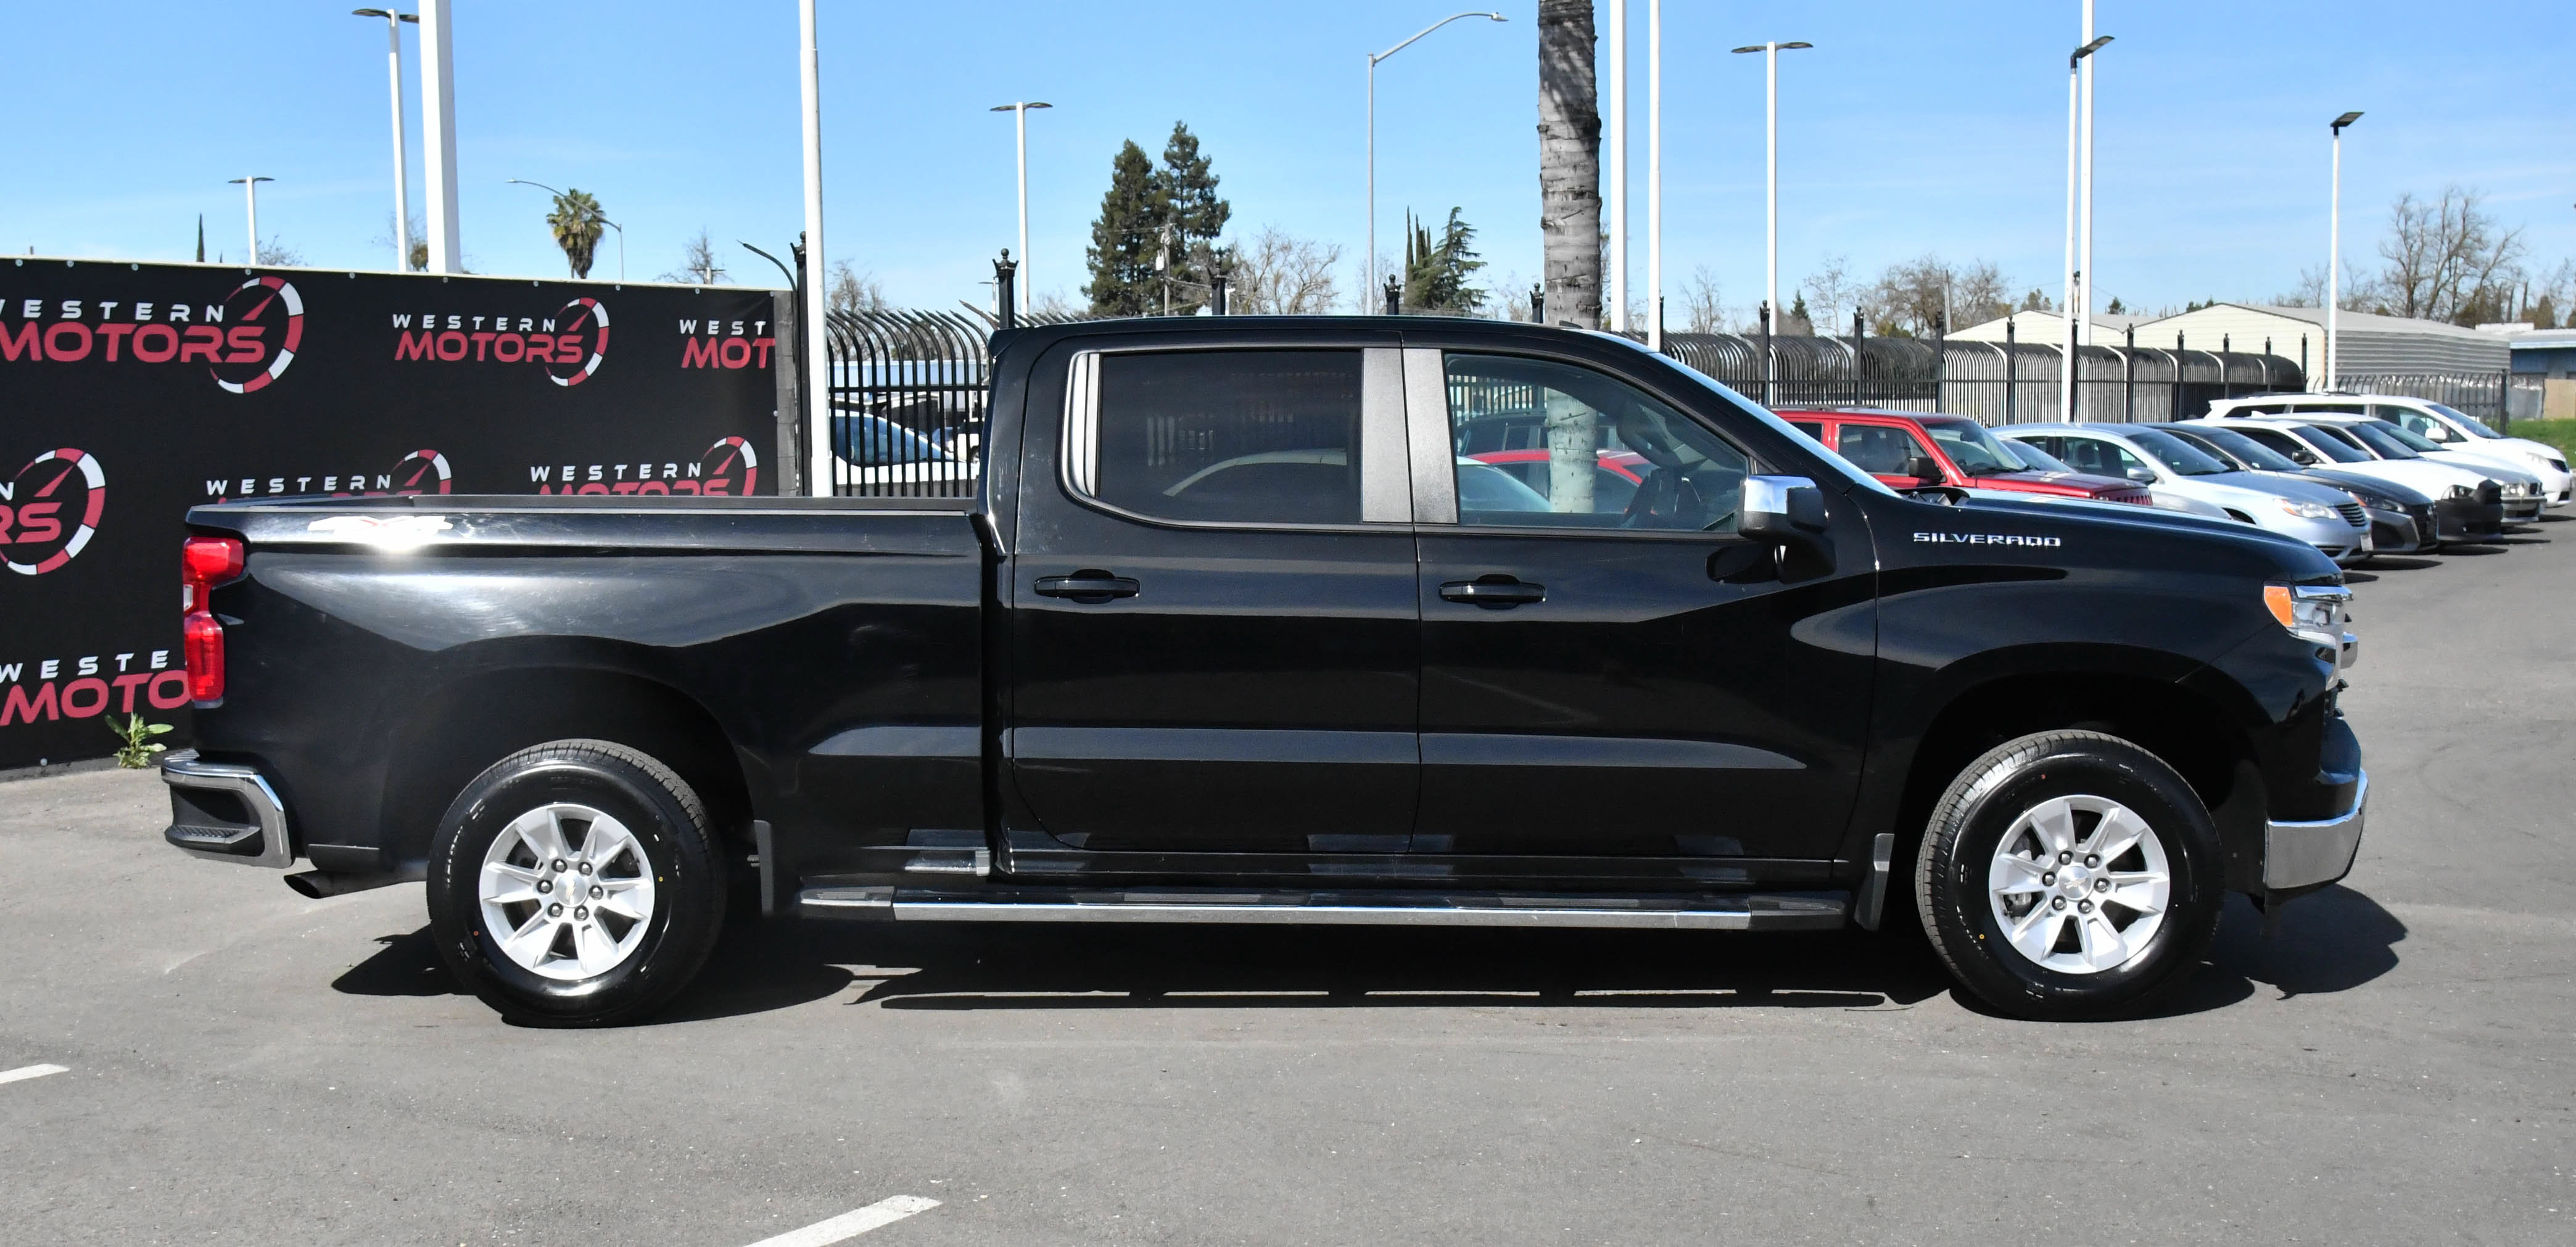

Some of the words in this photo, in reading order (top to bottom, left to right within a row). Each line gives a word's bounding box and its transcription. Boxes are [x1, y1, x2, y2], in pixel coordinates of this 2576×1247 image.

[392, 314, 556, 332] WESTERN
[679, 319, 766, 335] WEST
[0, 321, 266, 363] MOTORS
[395, 331, 583, 363] MOTORS
[681, 336, 775, 369] MOT
[530, 462, 701, 482] WESTERN
[207, 474, 391, 496] WESTERN
[1913, 532, 2062, 547] SILVERADO
[0, 650, 186, 683] WESTE
